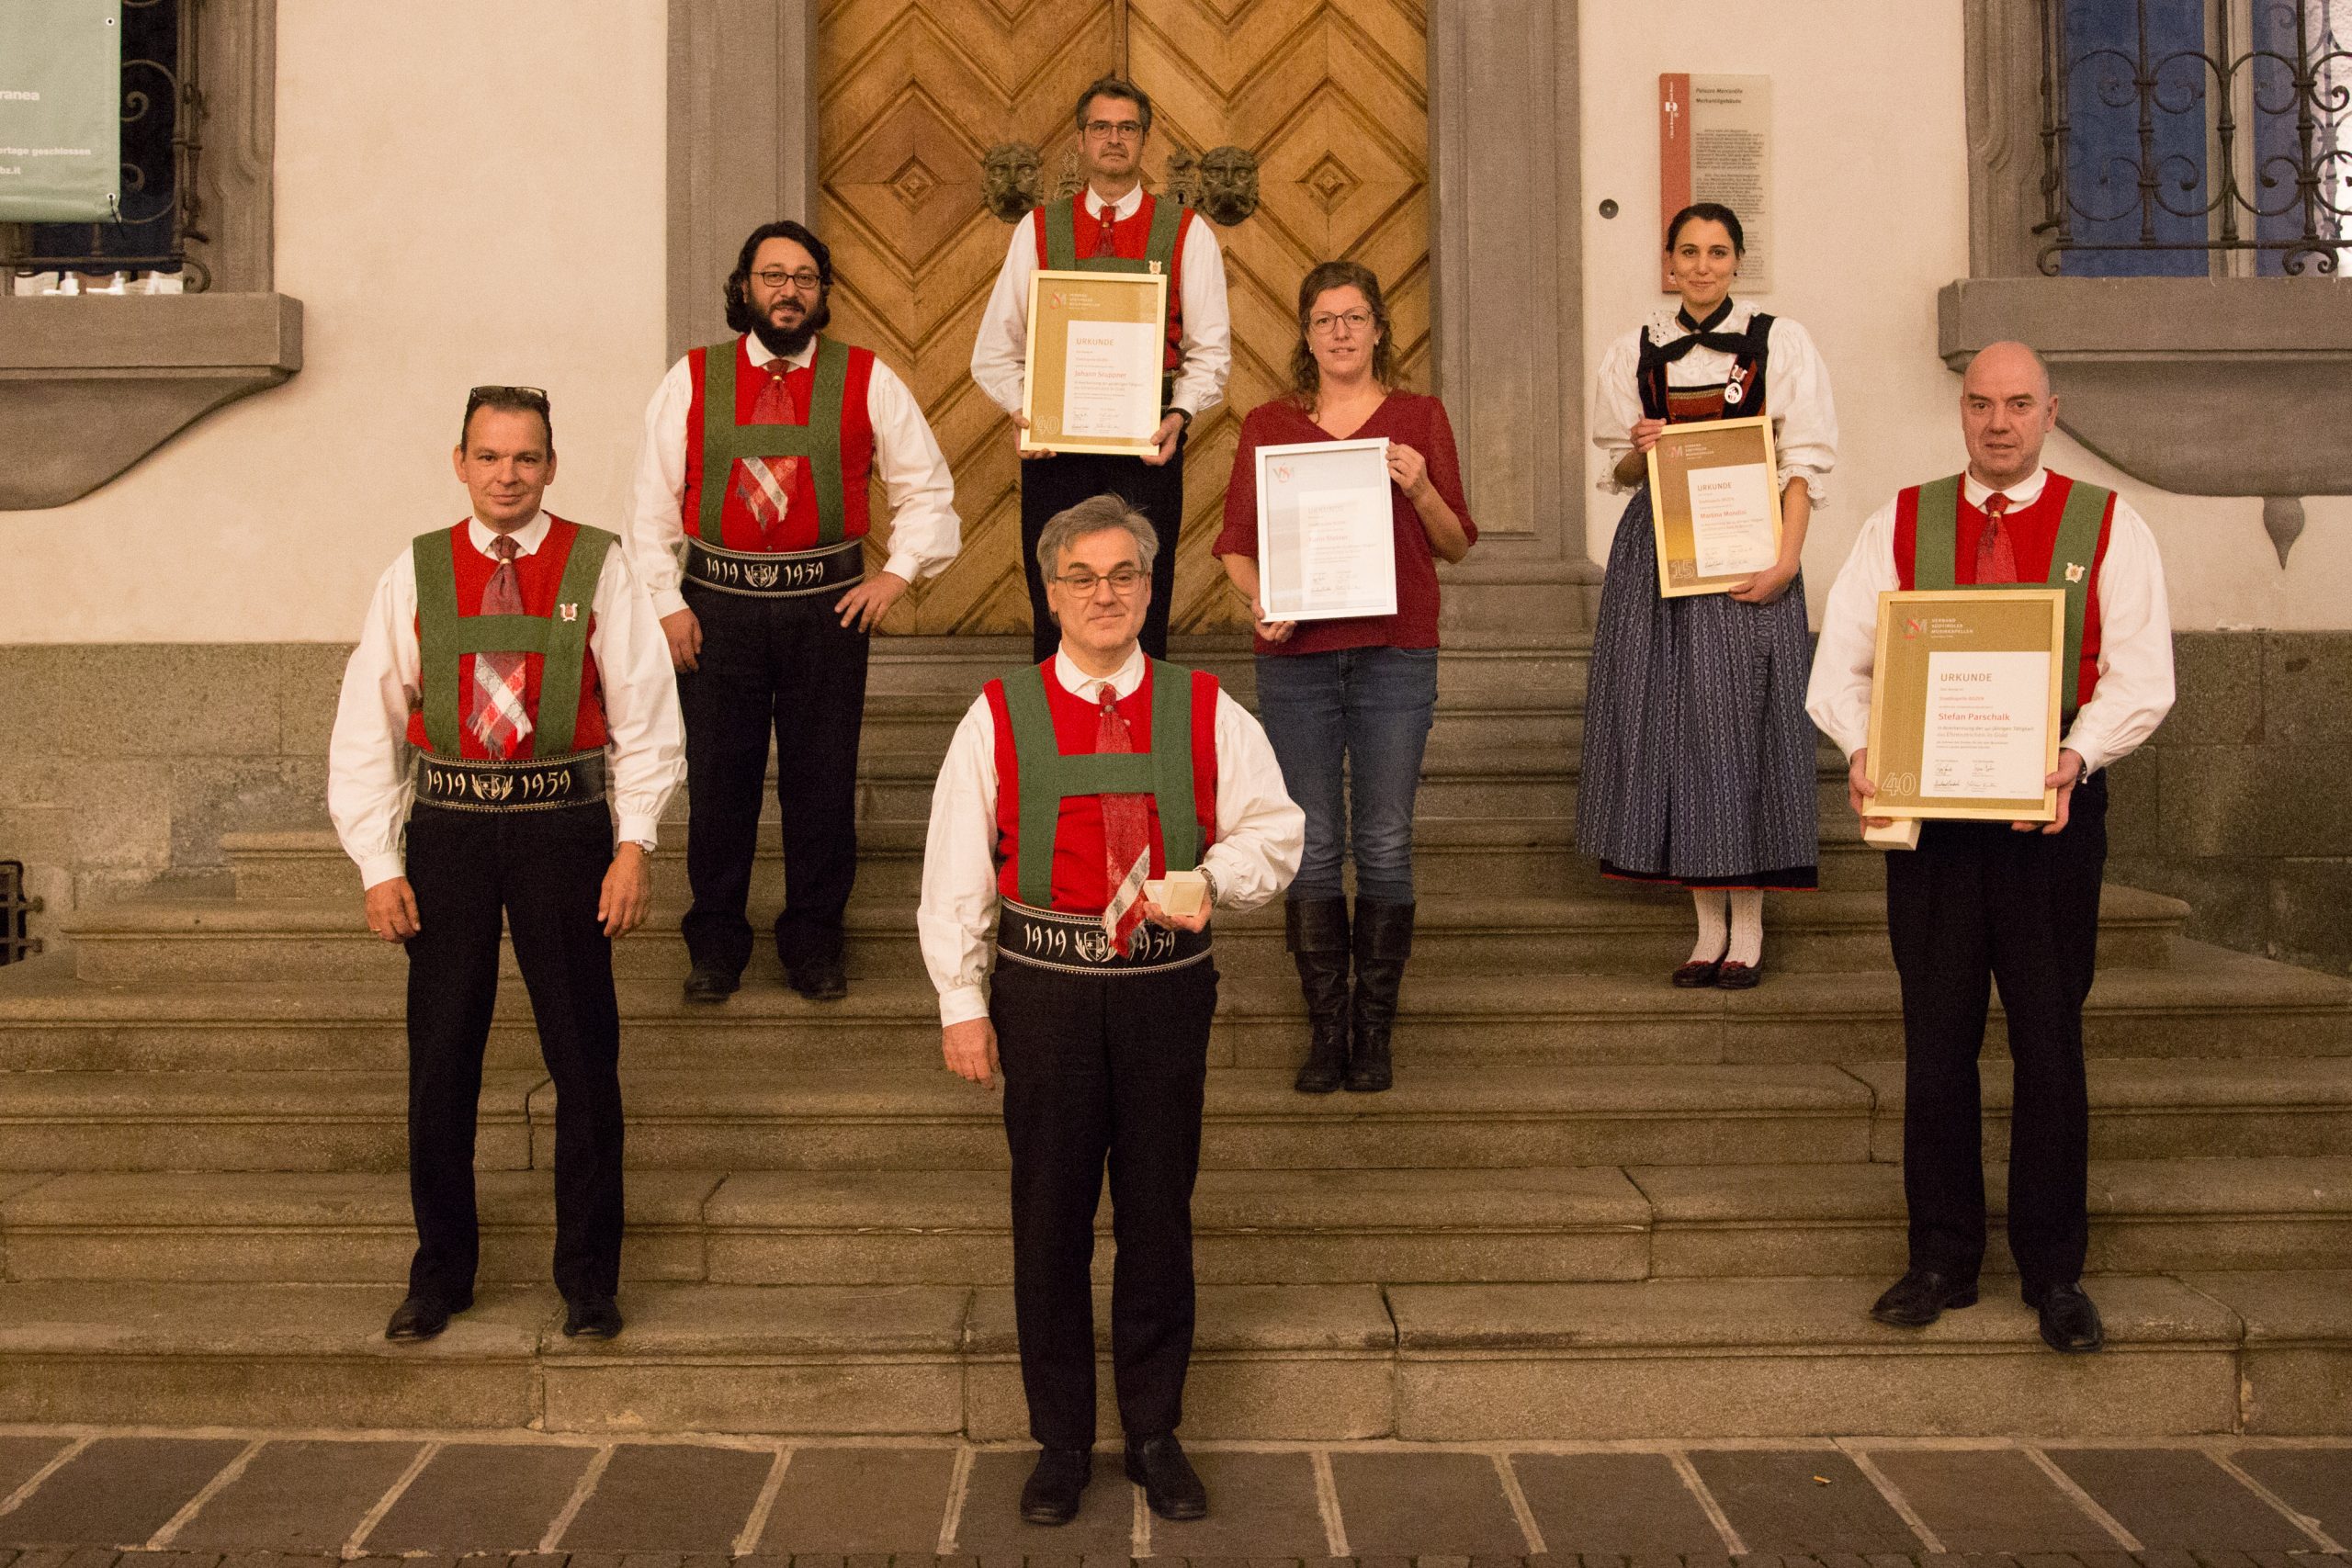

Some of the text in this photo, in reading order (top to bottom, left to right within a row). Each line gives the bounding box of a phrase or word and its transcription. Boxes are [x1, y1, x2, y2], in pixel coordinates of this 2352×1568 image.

[32, 147, 91, 156] geschlossen
[1076, 337, 1114, 346] URKUNDE
[1035, 415, 1060, 434] 40
[1698, 481, 1733, 491] URKUNDE
[706, 557, 824, 587] 1919 1959
[1670, 558, 1695, 580] 15
[1940, 672, 1993, 682] URKUNDE
[1938, 712, 2010, 721] Stefan Parschalk
[426, 769, 571, 798] 1919 1959
[1881, 772, 1917, 796] 40
[1023, 922, 1067, 958] 1919
